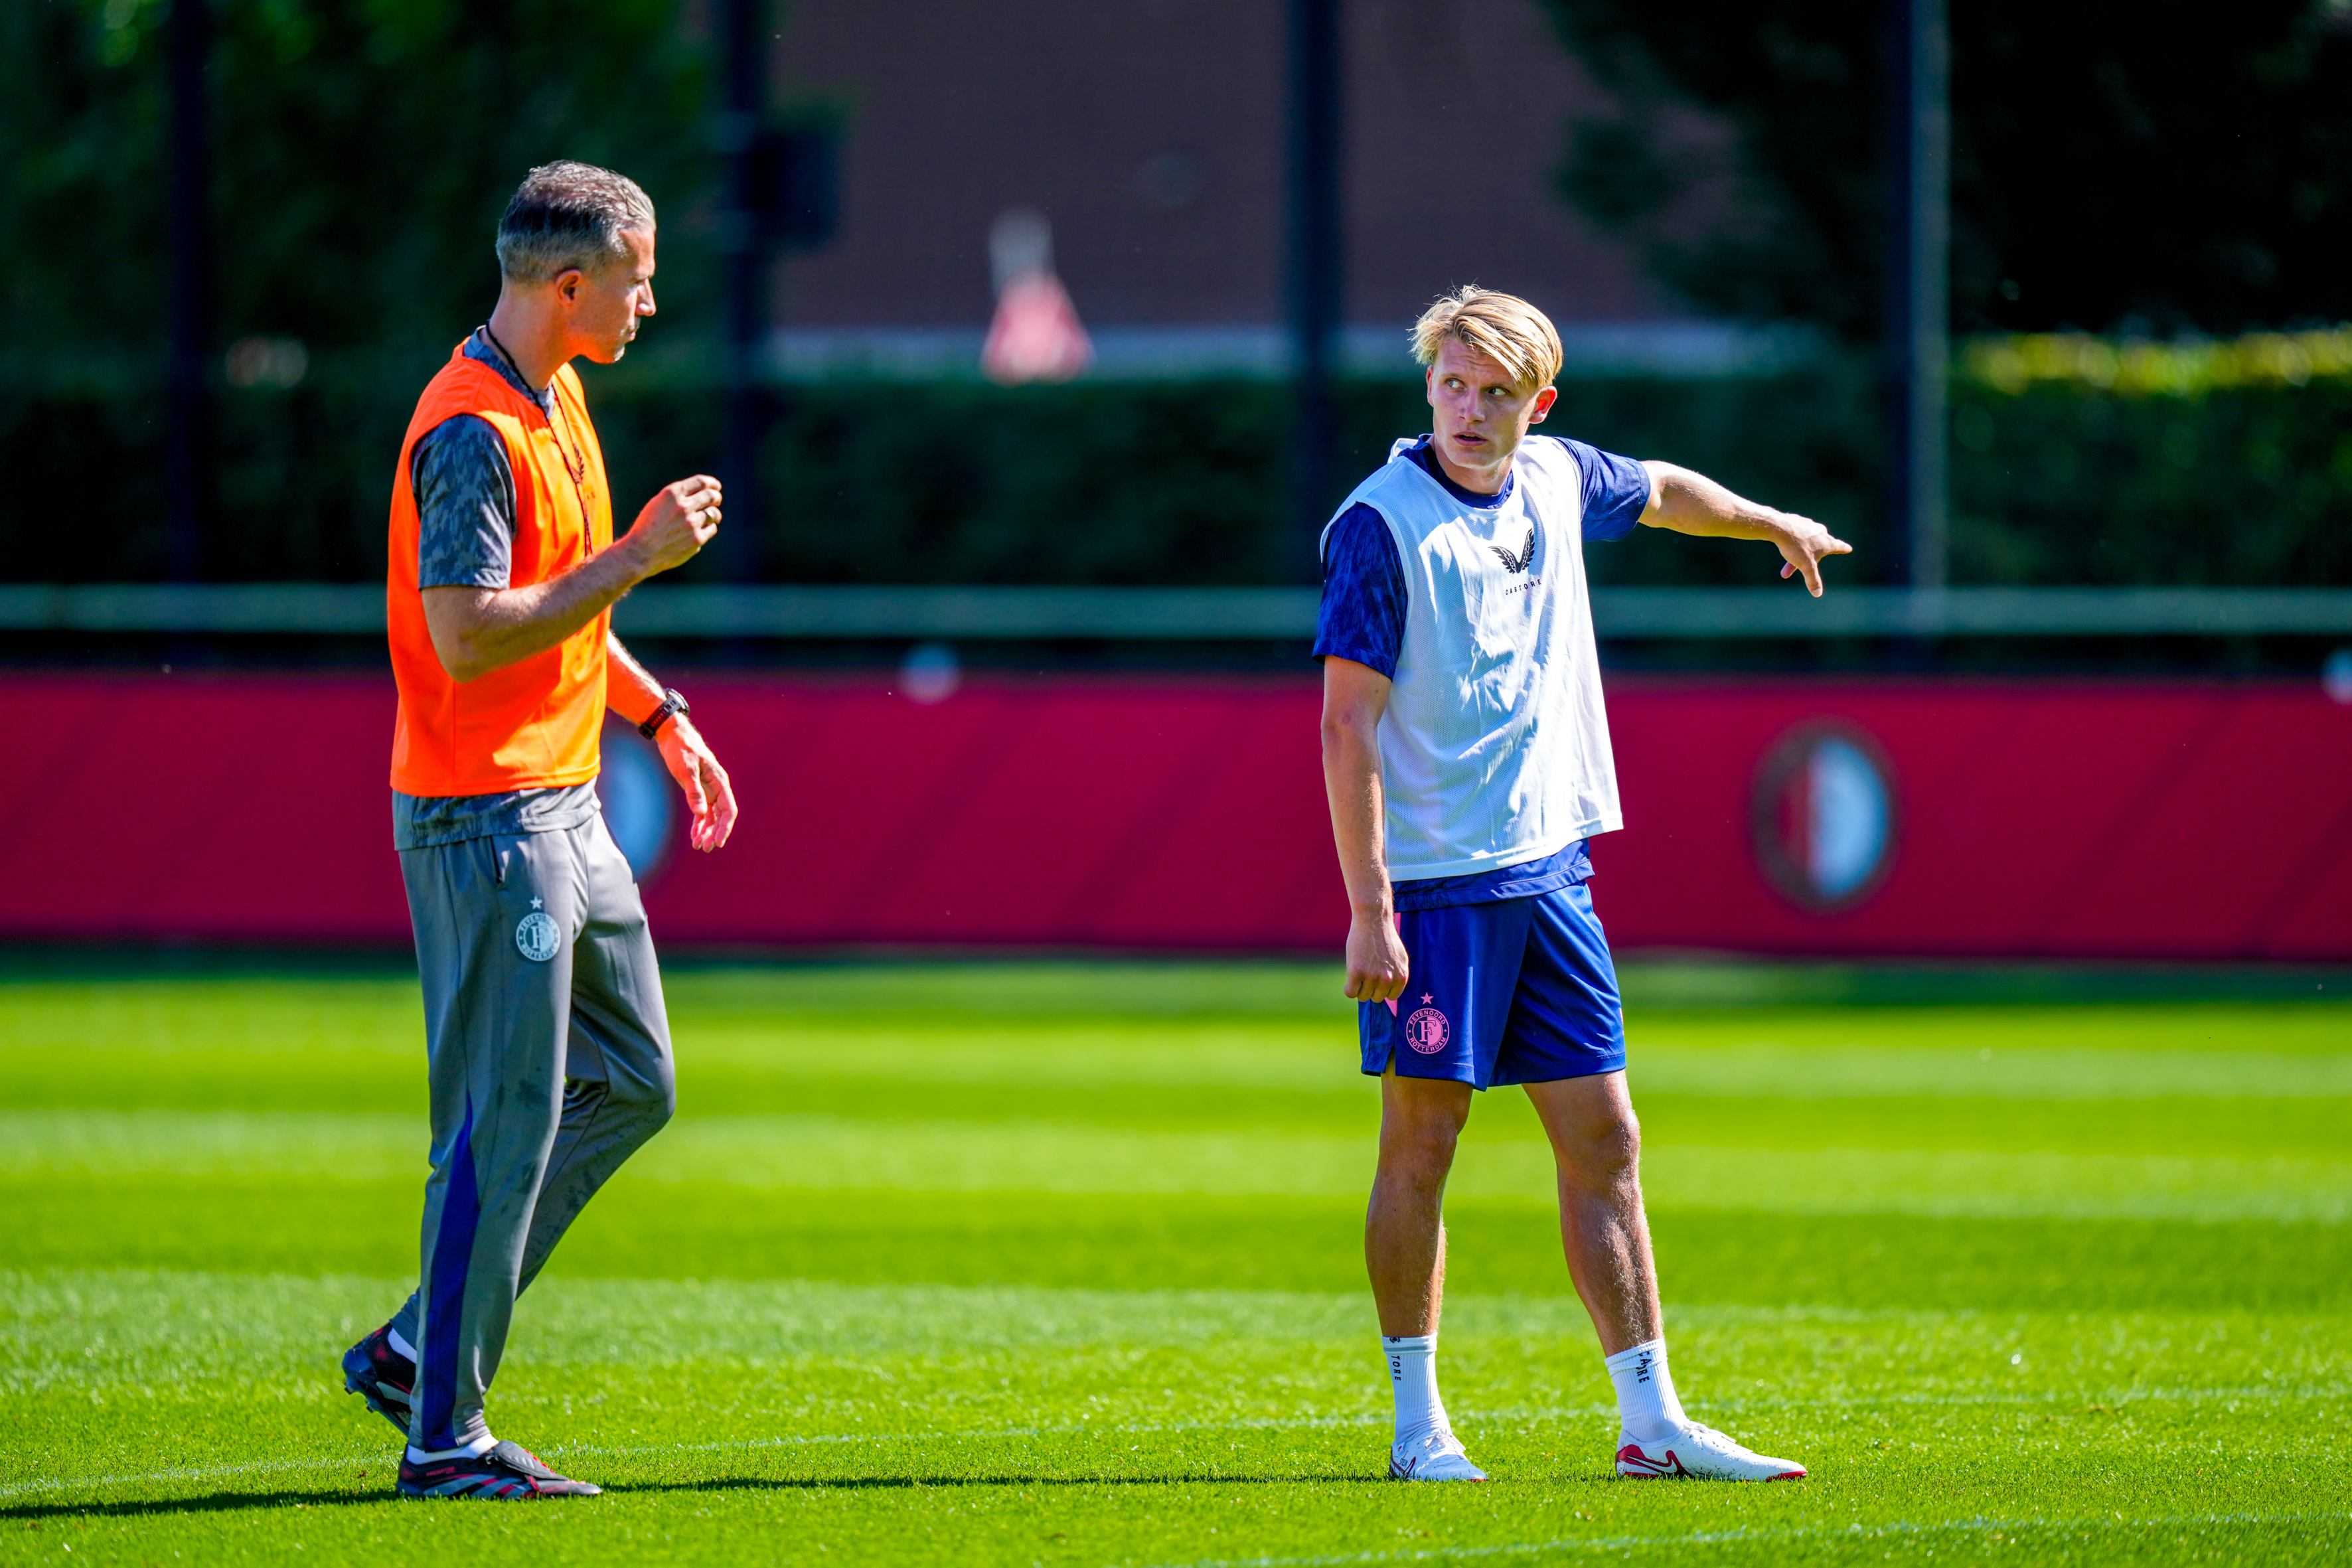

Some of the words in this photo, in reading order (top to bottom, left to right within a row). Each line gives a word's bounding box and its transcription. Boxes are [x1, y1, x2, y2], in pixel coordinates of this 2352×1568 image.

[1505, 578, 1541, 595] CASTORE
[1409, 1010, 1446, 1025] FEYENOORD
[1419, 1020, 1437, 1042] F
[1409, 1036, 1447, 1052] ROTTERDAM
